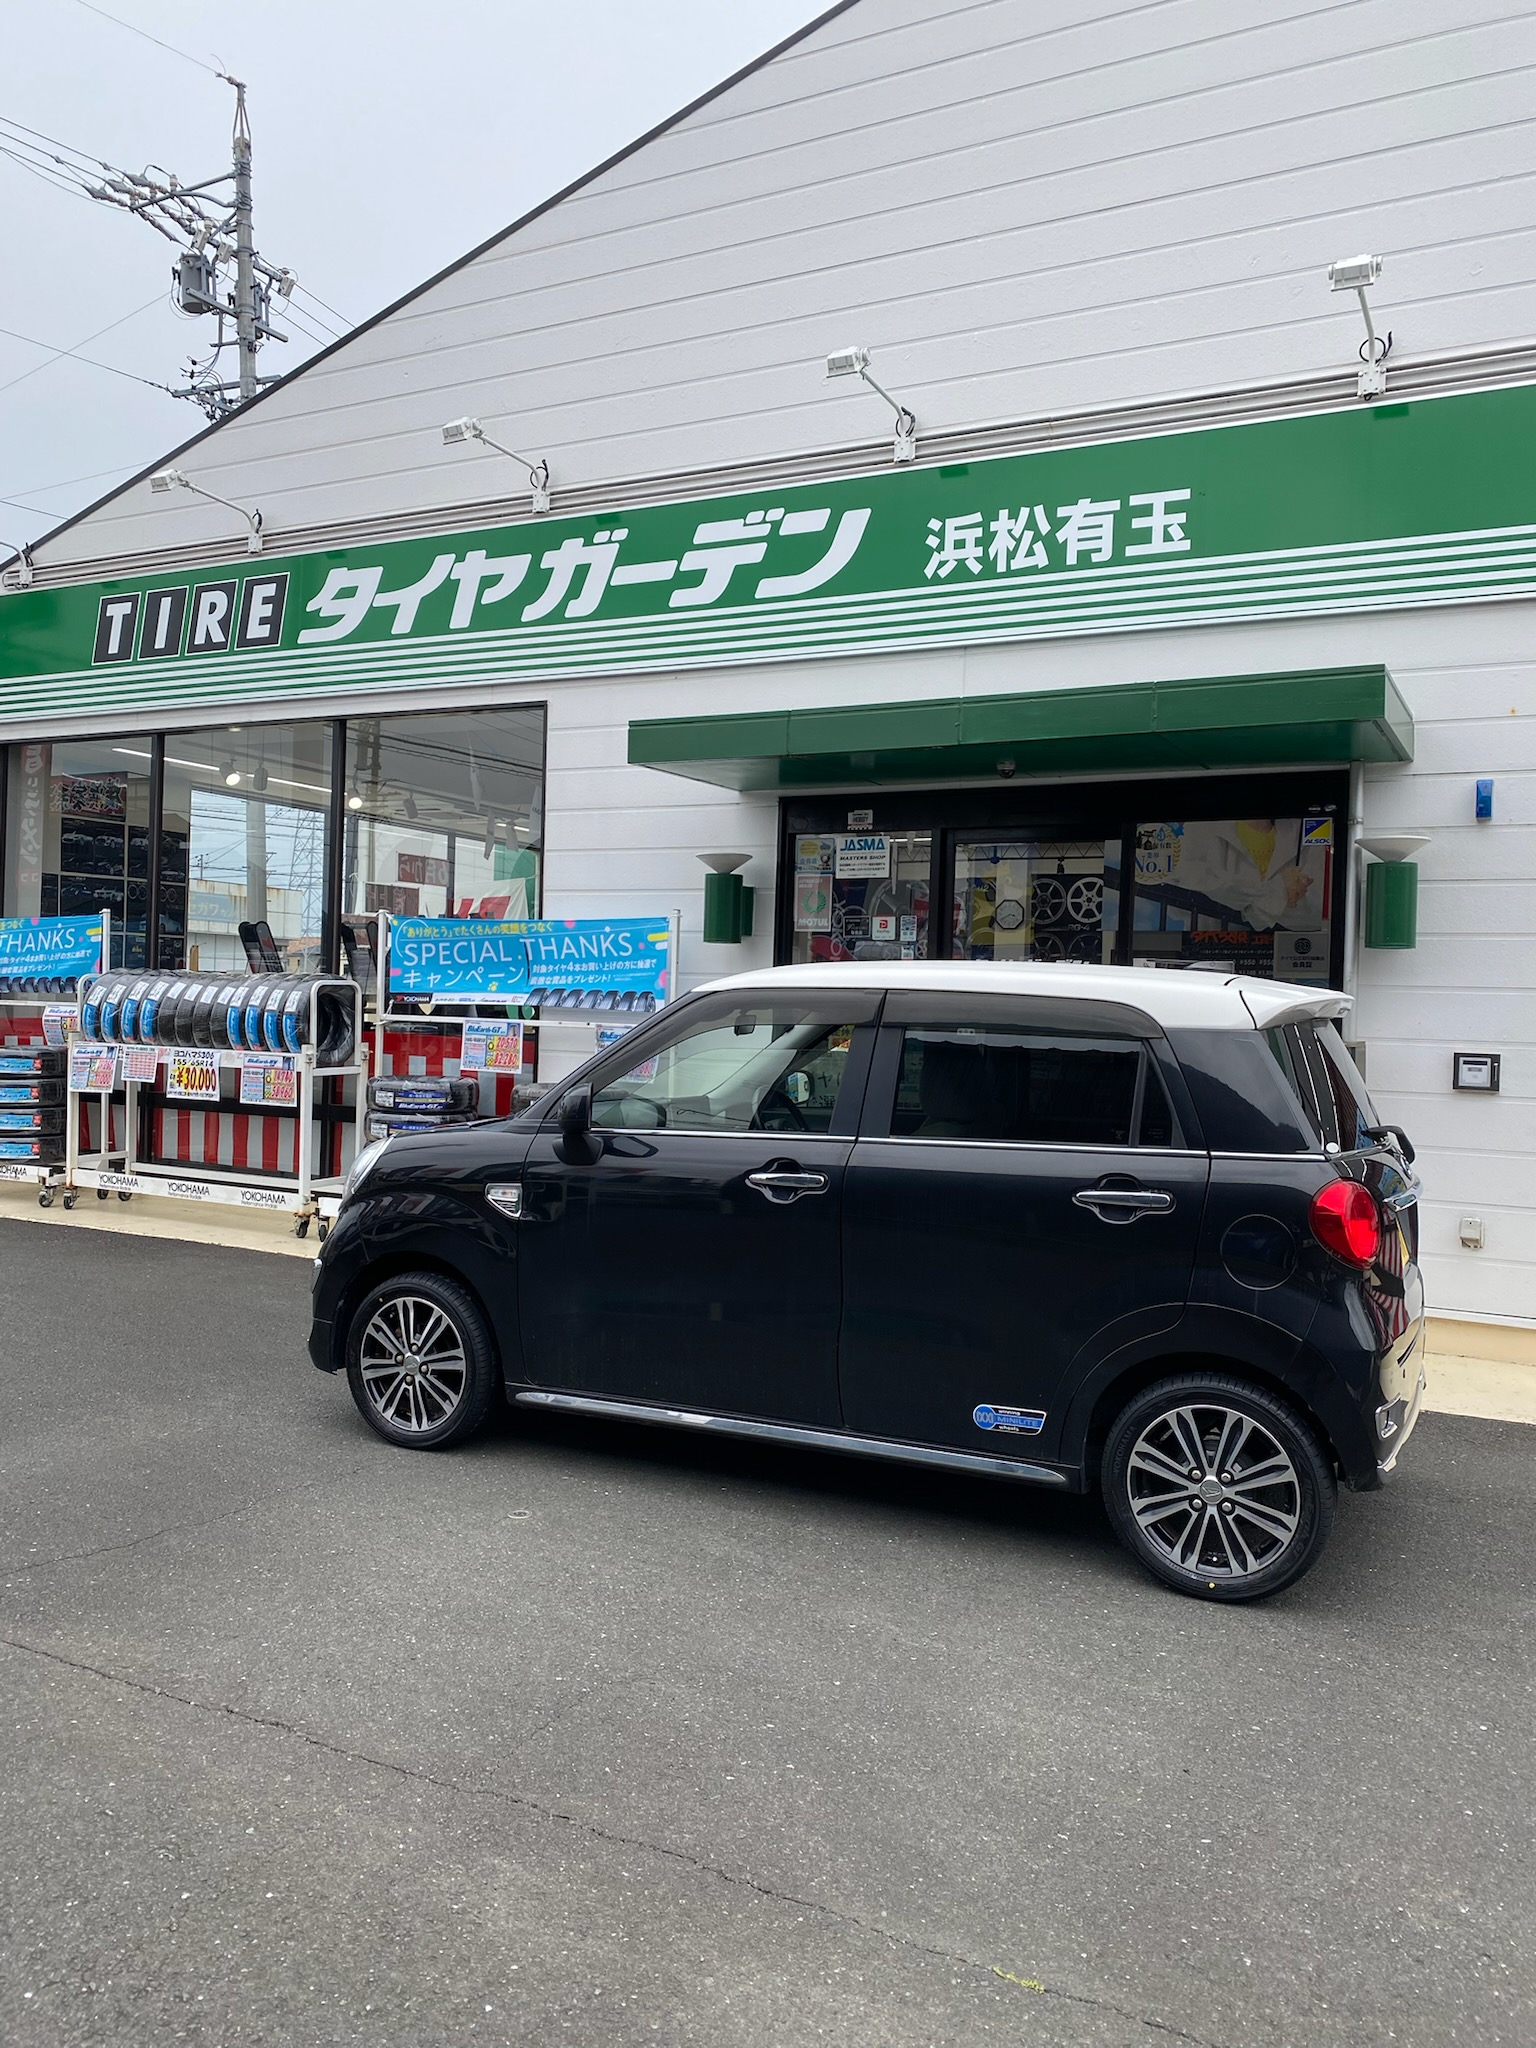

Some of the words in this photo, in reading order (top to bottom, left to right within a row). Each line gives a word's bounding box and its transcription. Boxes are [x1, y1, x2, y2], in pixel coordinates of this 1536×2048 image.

[923, 488, 1192, 580] 浜松有玉
[297, 507, 872, 645] タイヤガーデン
[104, 583, 277, 655] TIRE
[840, 838, 885, 852] JASMA
[402, 939, 513, 967] SPECIAL
[519, 932, 633, 961] THANKS
[402, 965, 525, 989] キャンペーン
[98, 1174, 139, 1188] YOKOHAMA
[167, 1182, 210, 1196] YOKOHAMA
[240, 1190, 287, 1205] YOKOHAMA
